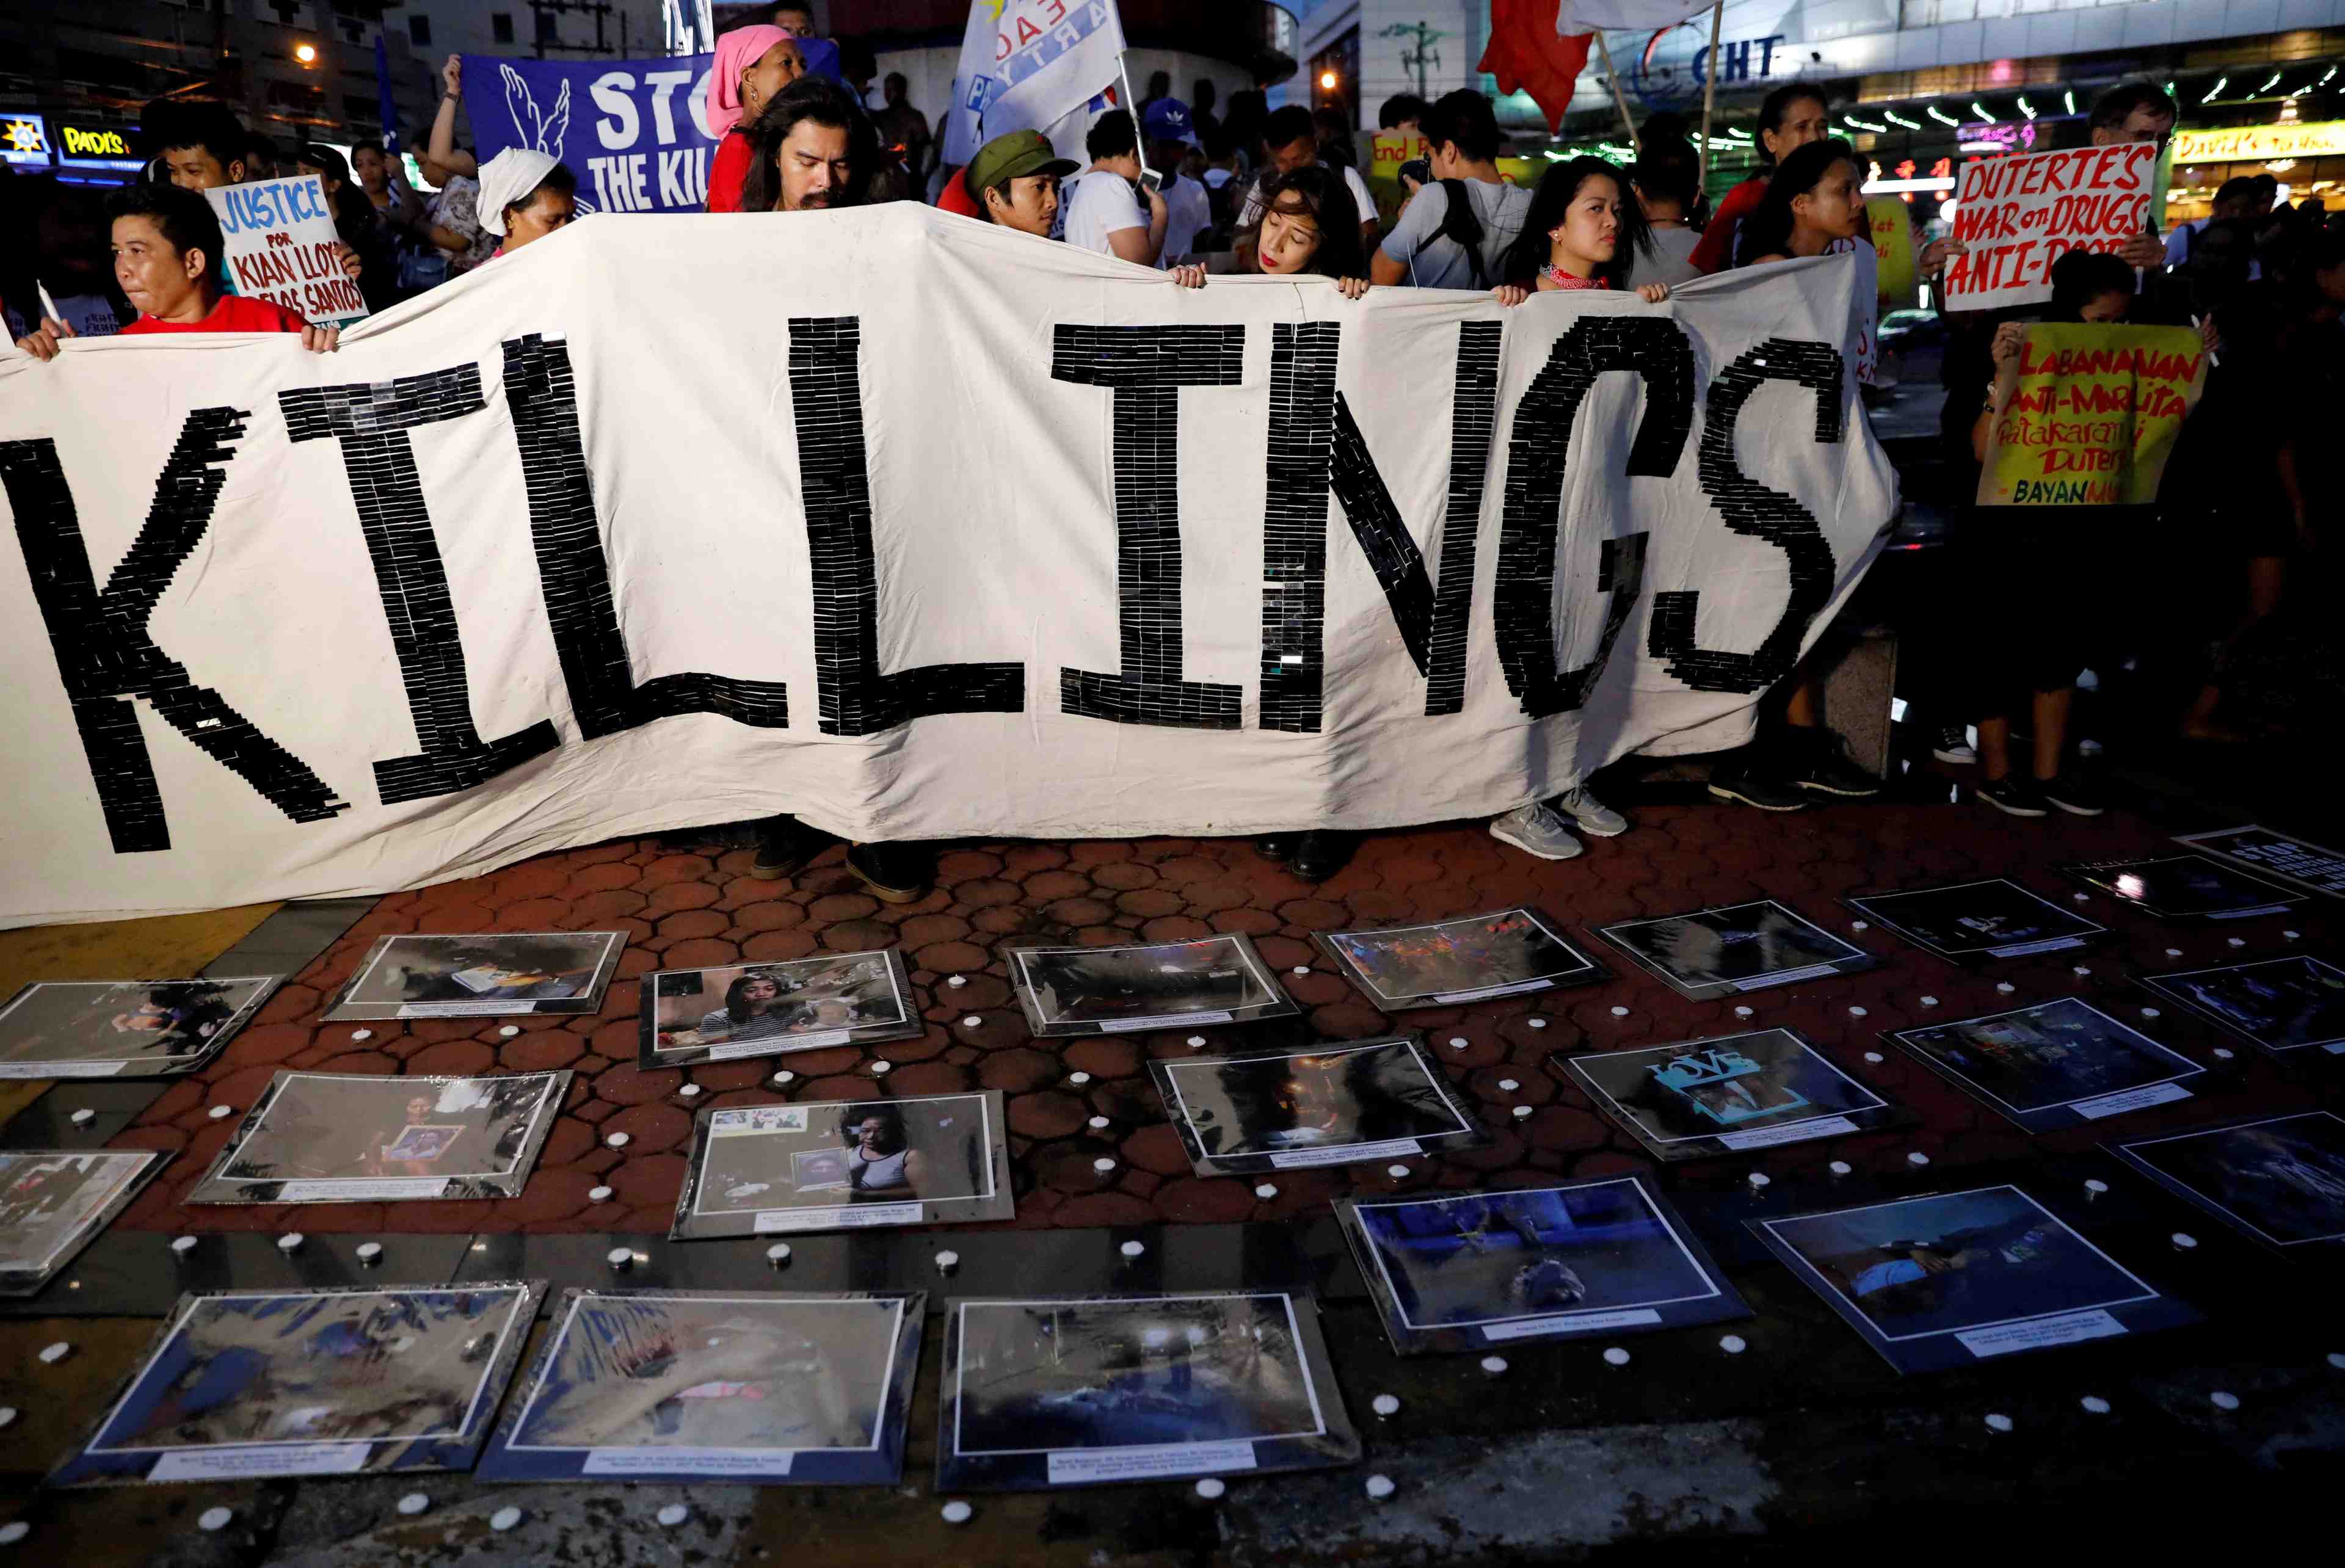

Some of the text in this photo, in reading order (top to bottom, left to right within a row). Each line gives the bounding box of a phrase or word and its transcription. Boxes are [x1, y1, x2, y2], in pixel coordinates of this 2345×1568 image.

[63, 127, 124, 154] PADI'S
[1372, 134, 1407, 161] End
[2181, 132, 2258, 157] David's
[587, 153, 653, 212] THE
[658, 144, 722, 208] KIL
[1959, 145, 2156, 204] DUTERTE'S
[220, 180, 327, 233] JUSTICE
[1953, 202, 2020, 242] WAR
[233, 241, 347, 291] KIAN LLOY
[1946, 238, 2125, 297] ANTI-P
[304, 277, 363, 316] SANTOS
[0, 314, 1844, 854] KILLINGS
[2230, 842, 2305, 860] STOP
[1645, 1049, 1760, 1082] LOVE
